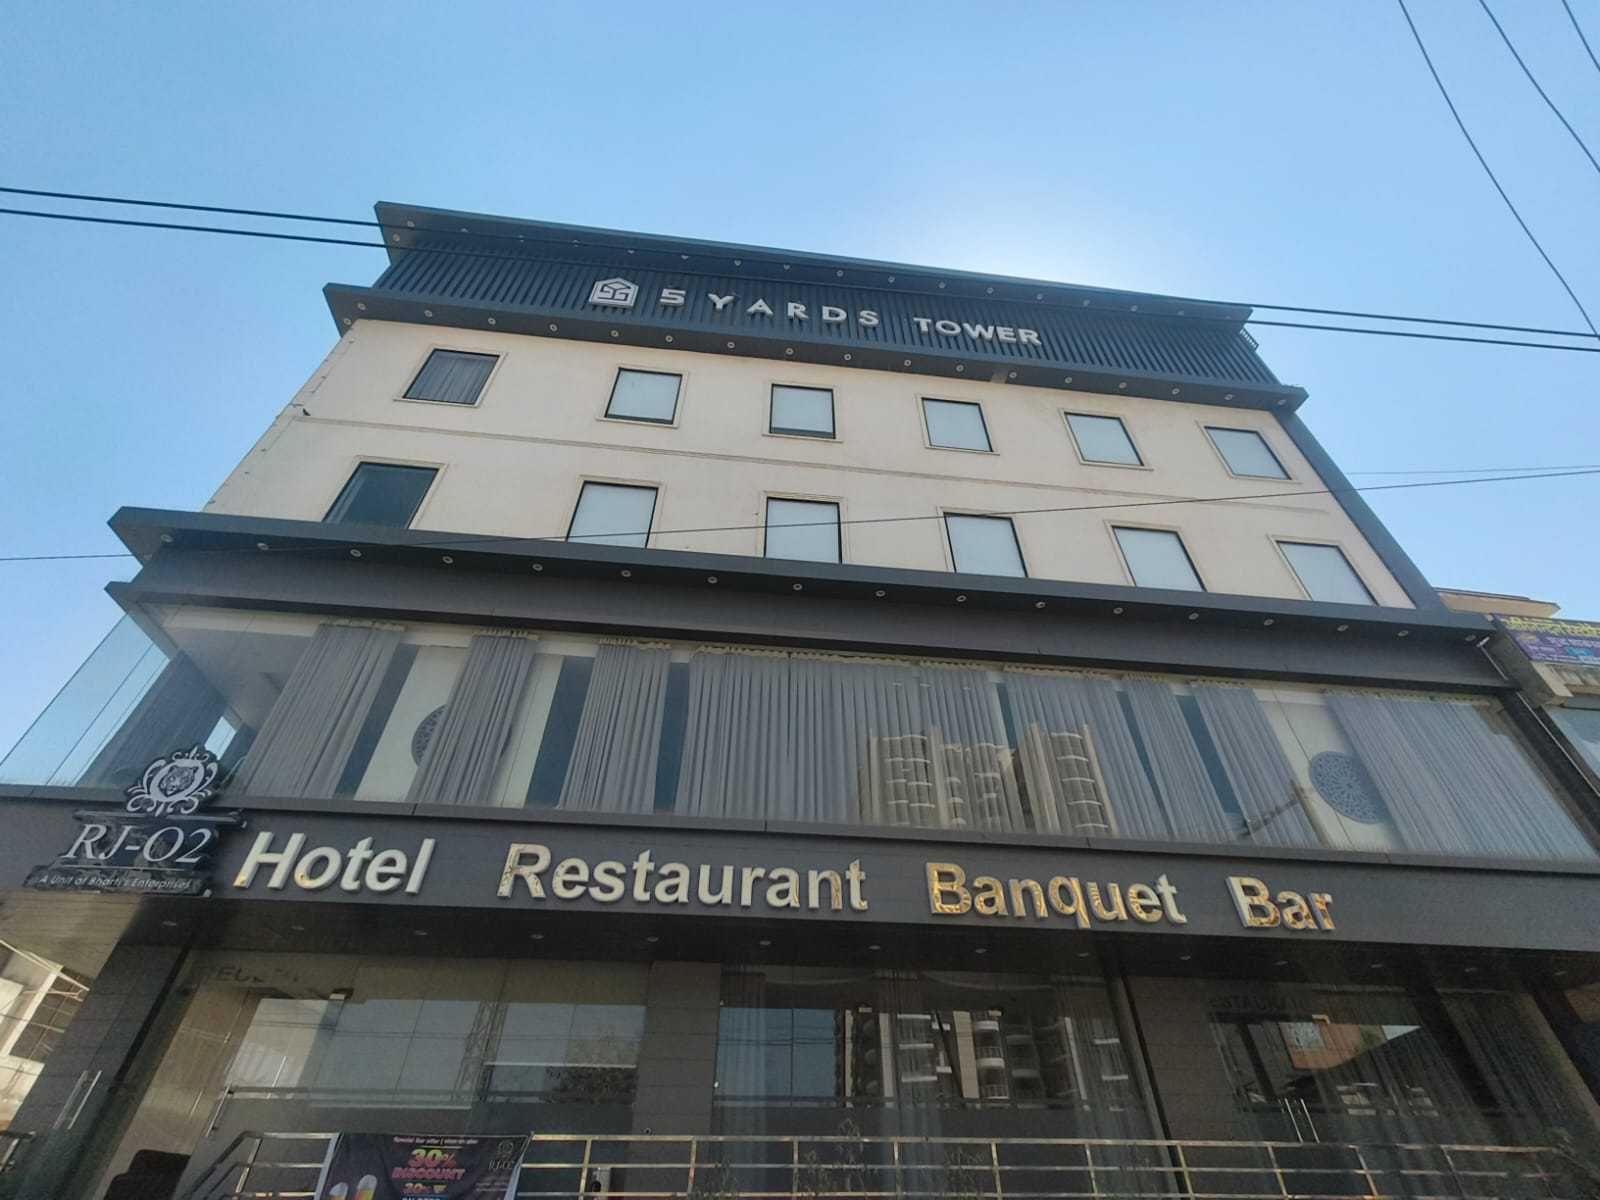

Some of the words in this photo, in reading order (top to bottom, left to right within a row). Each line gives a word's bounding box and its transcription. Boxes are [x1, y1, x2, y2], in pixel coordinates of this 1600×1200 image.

[659, 288, 687, 306] 5
[708, 292, 880, 328] YARDS
[914, 317, 1043, 347] TOWER
[232, 831, 437, 895] Hotel
[497, 843, 869, 911] Restaurant
[926, 862, 1188, 929] Banquet
[1225, 875, 1337, 931] Bar
[391, 1167, 466, 1181] DISCOUNT
[407, 1148, 457, 1169] 30%
